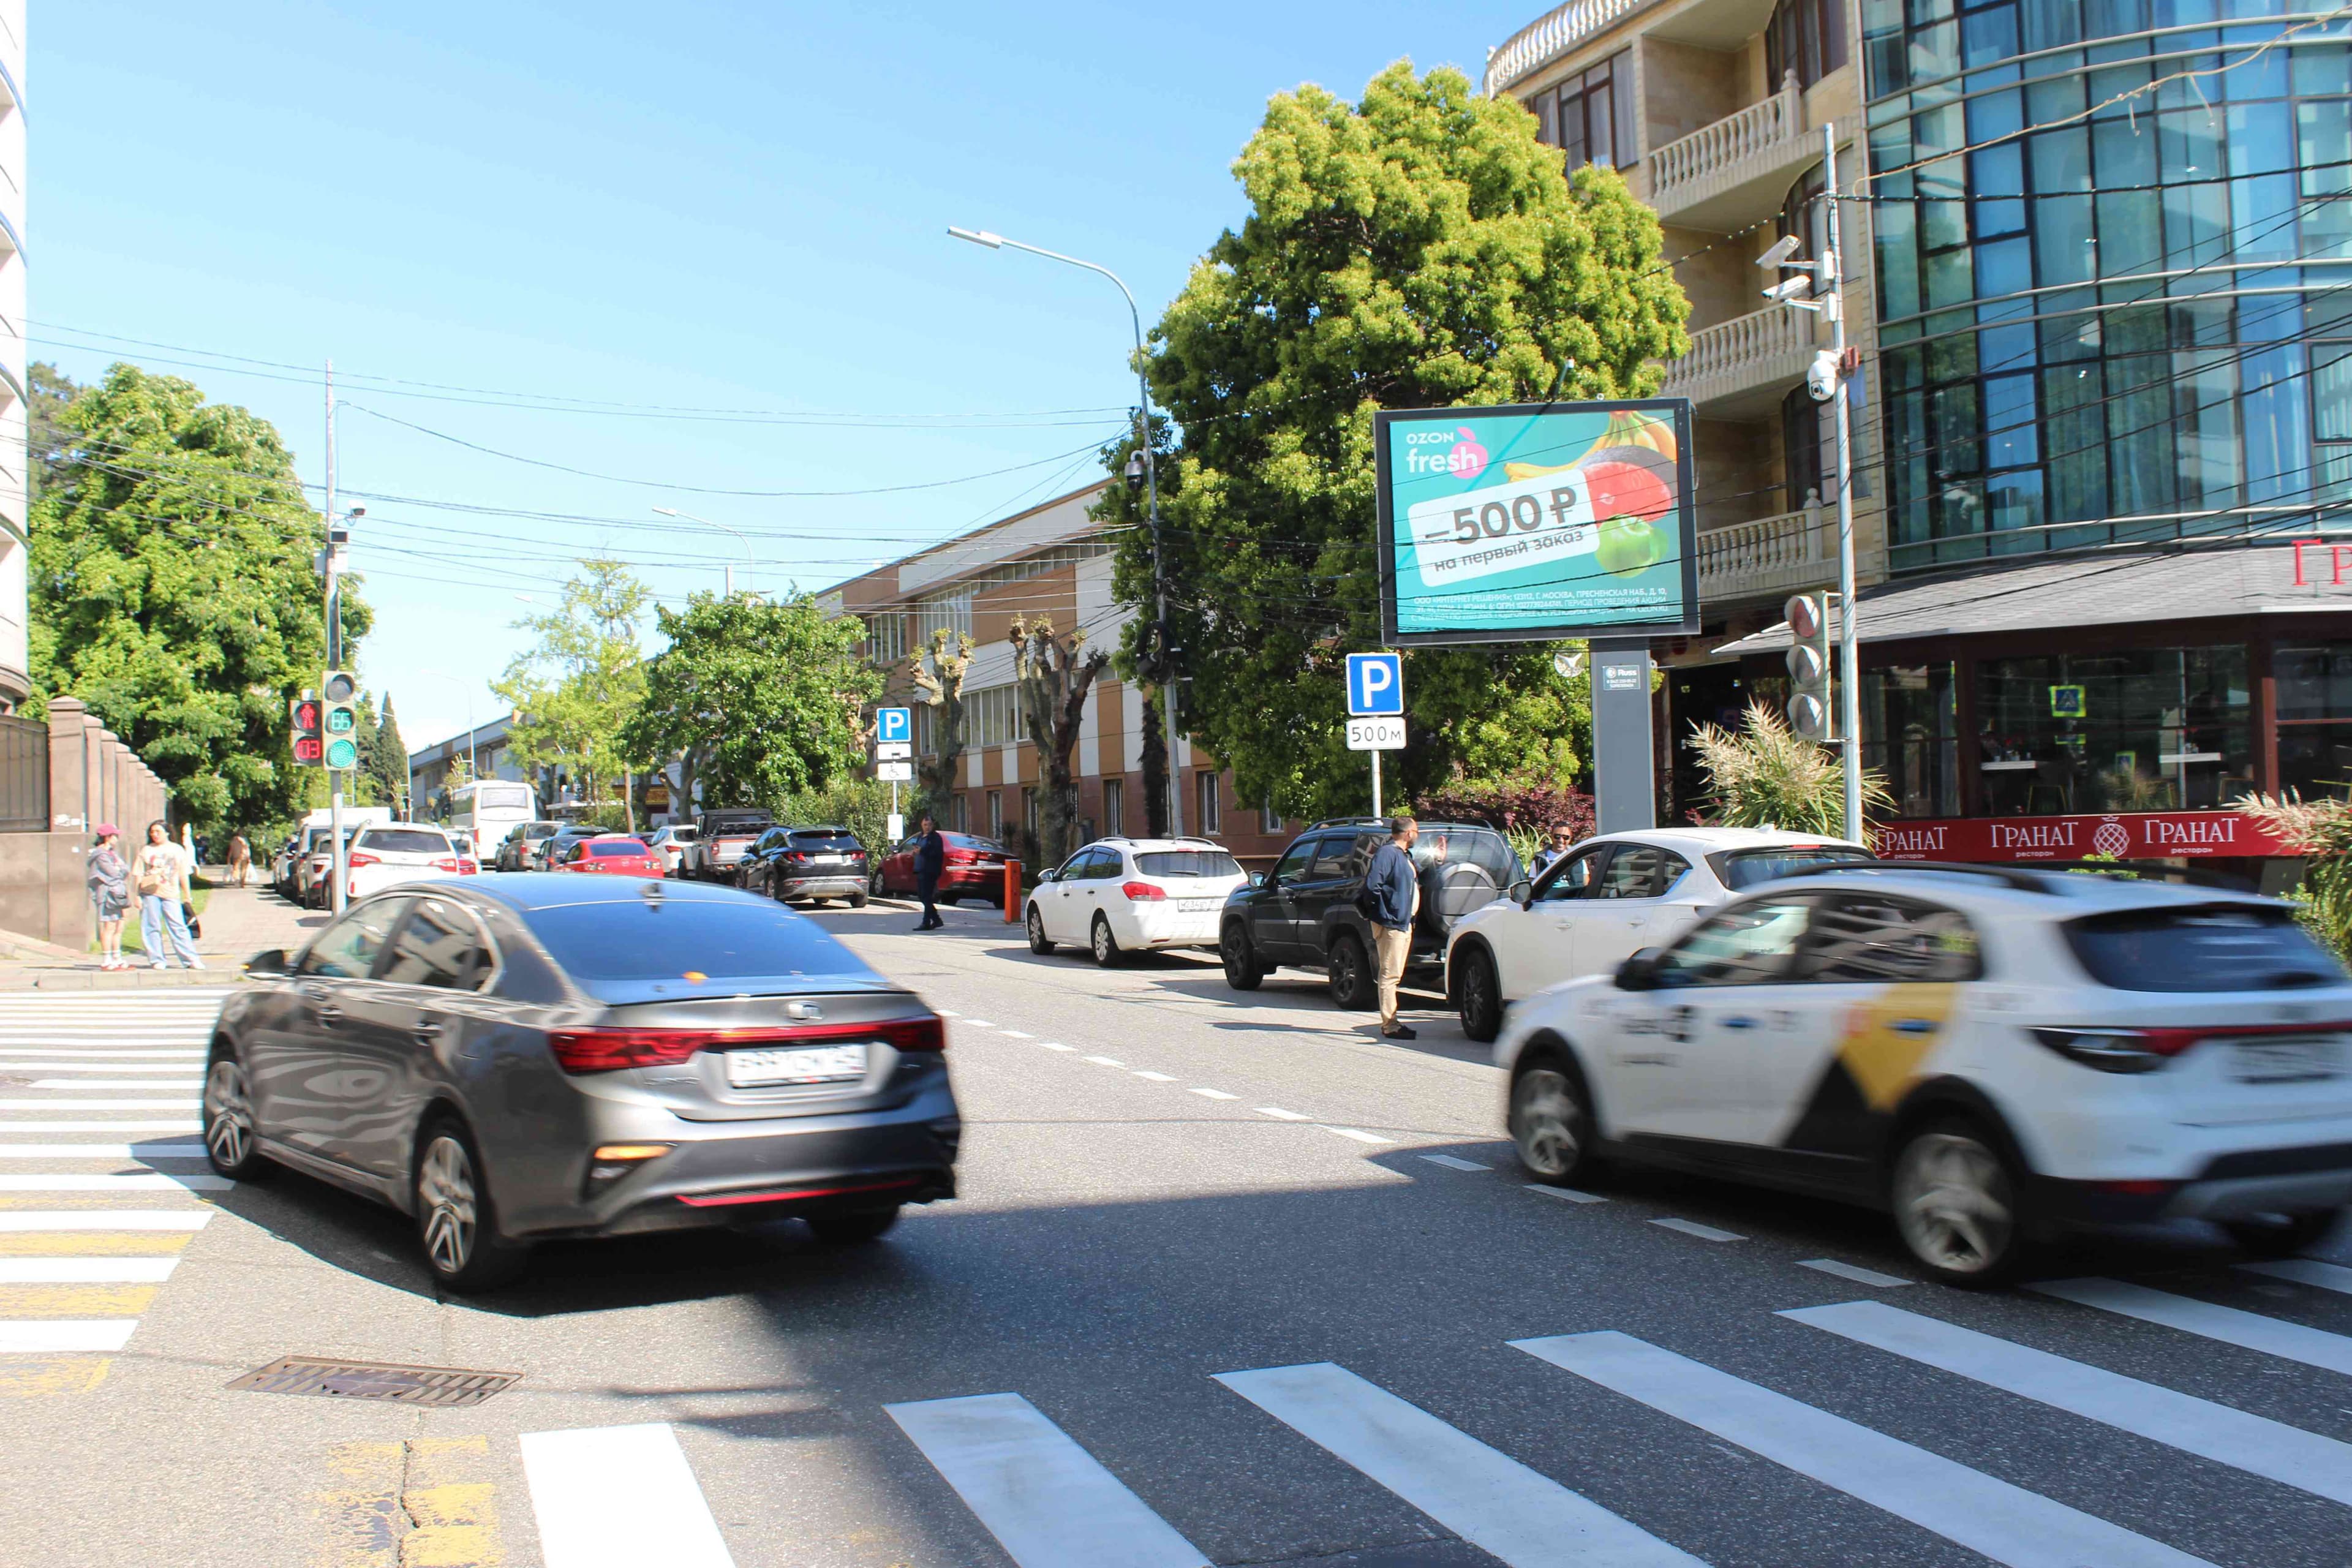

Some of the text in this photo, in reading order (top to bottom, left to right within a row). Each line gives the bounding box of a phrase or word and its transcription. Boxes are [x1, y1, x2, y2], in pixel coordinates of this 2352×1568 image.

[1406, 432, 1454, 445] OZON
[1406, 446, 1478, 473] fresh
[1434, 530, 1583, 571] на первый заказ
[1576, 589, 1627, 598] ПРЕСНЕНСКАЯ
[1362, 661, 1391, 707] P
[886, 712, 905, 738] P
[1874, 827, 1948, 851] ГРАНАТ
[1991, 822, 2079, 848] ГРАНАТ
[2144, 818, 2239, 844] ГРАНАТ
